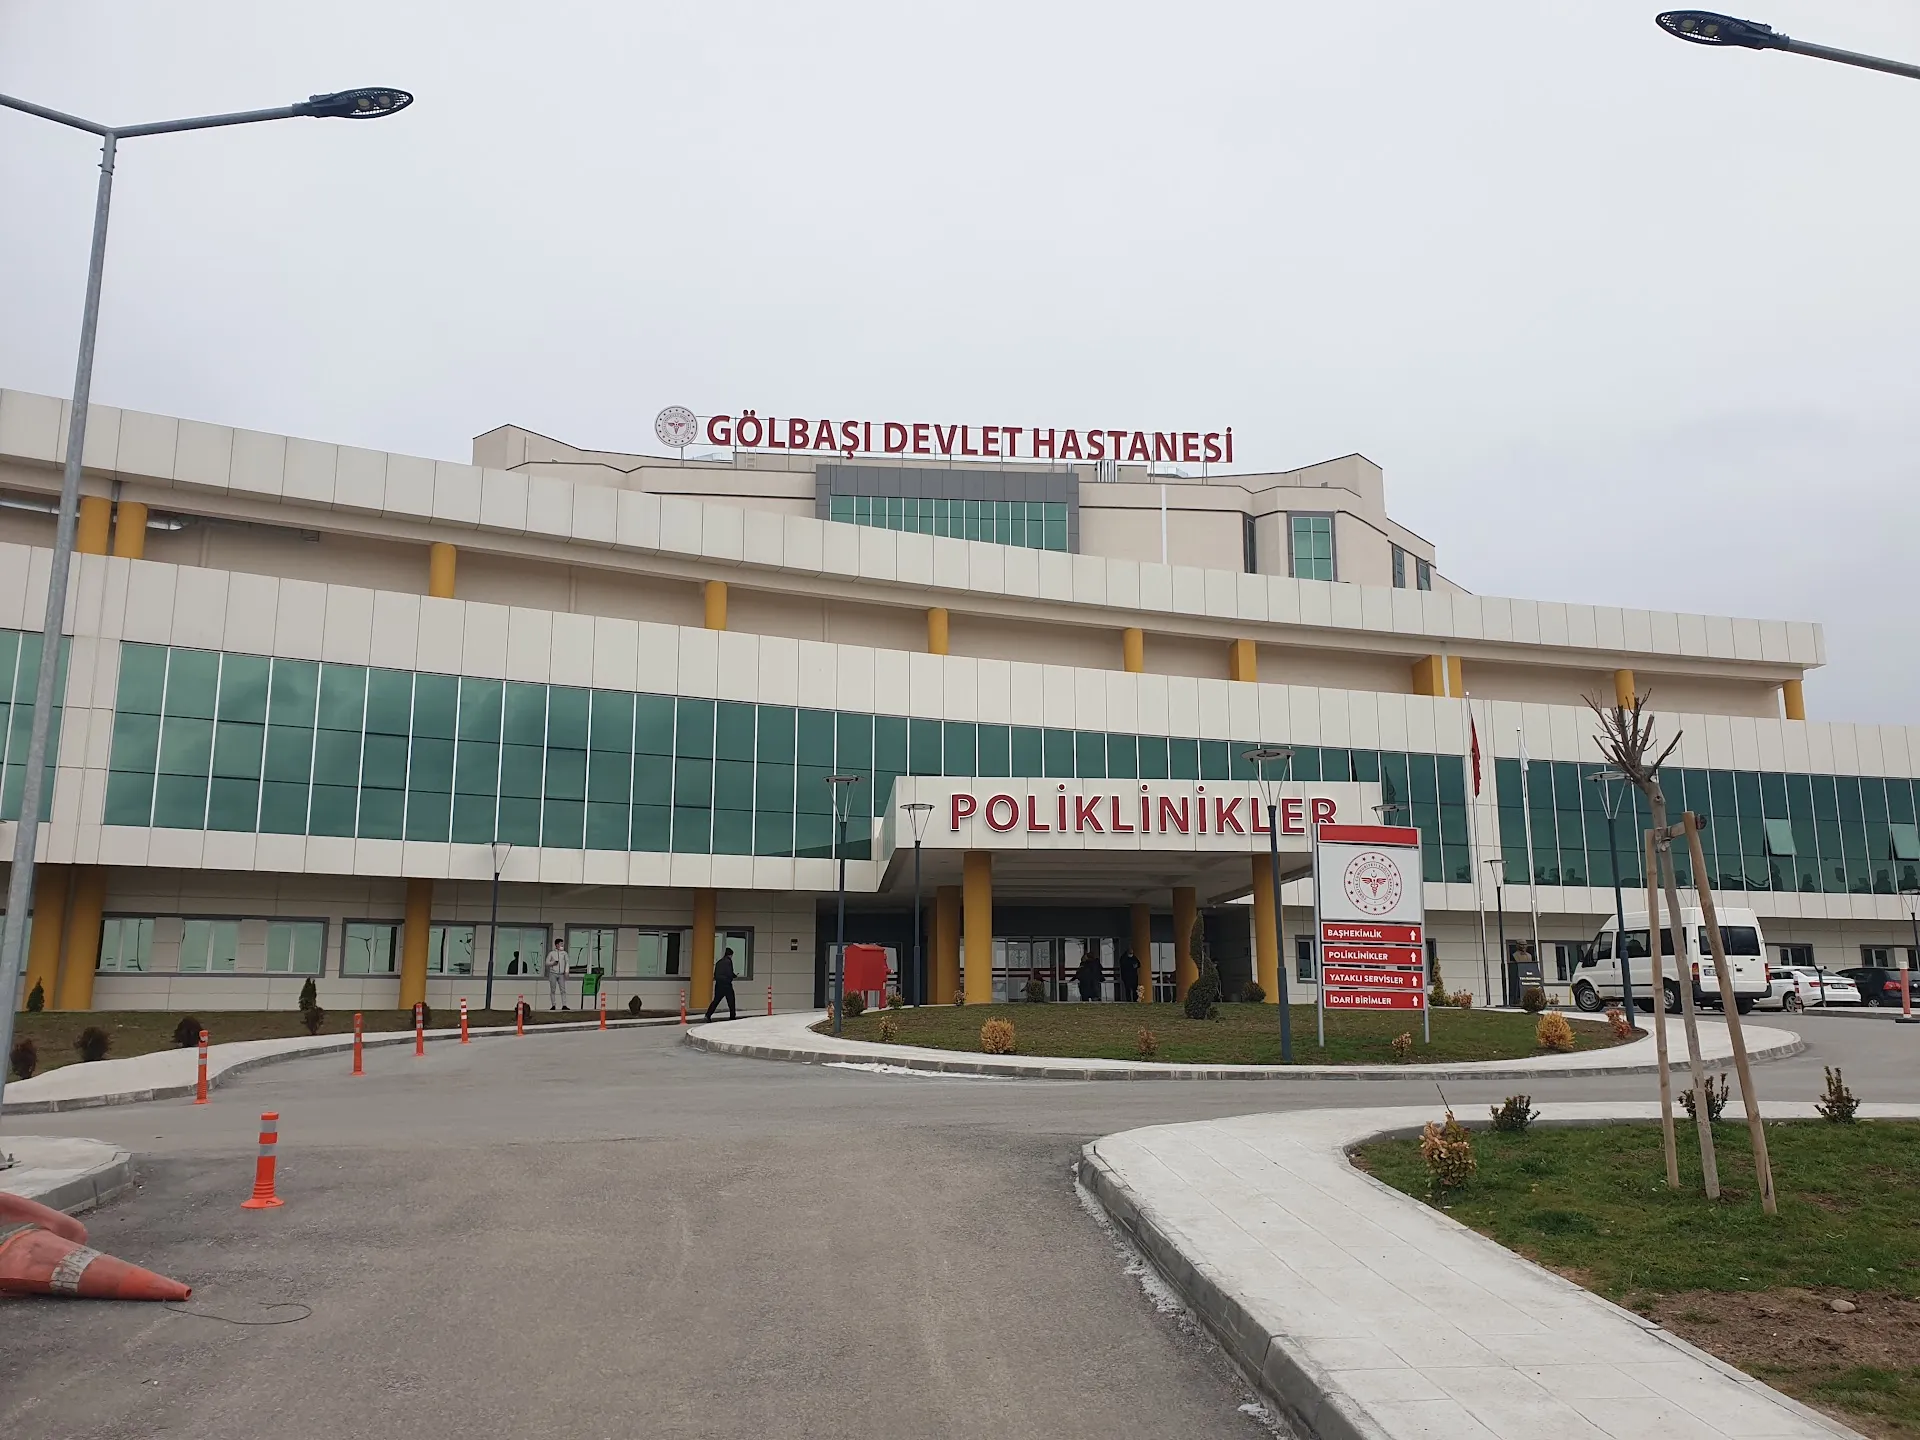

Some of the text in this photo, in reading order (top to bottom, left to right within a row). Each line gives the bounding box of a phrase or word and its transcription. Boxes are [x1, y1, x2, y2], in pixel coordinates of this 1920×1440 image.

[706, 409, 873, 461] GÖLBAŞI
[883, 422, 1023, 458] DEVLET
[1033, 426, 1233, 464] HASTANESİ
[949, 782, 1338, 835] POLİKLİNİKLER
[1327, 929, 1382, 939] BAŞHEKİMLİK
[1328, 950, 1388, 960] POLİKLİNİKLER
[1329, 973, 1404, 984] YATAKLI SERVİSLER
[1330, 994, 1392, 1005] İDARİ BİRİMLER
